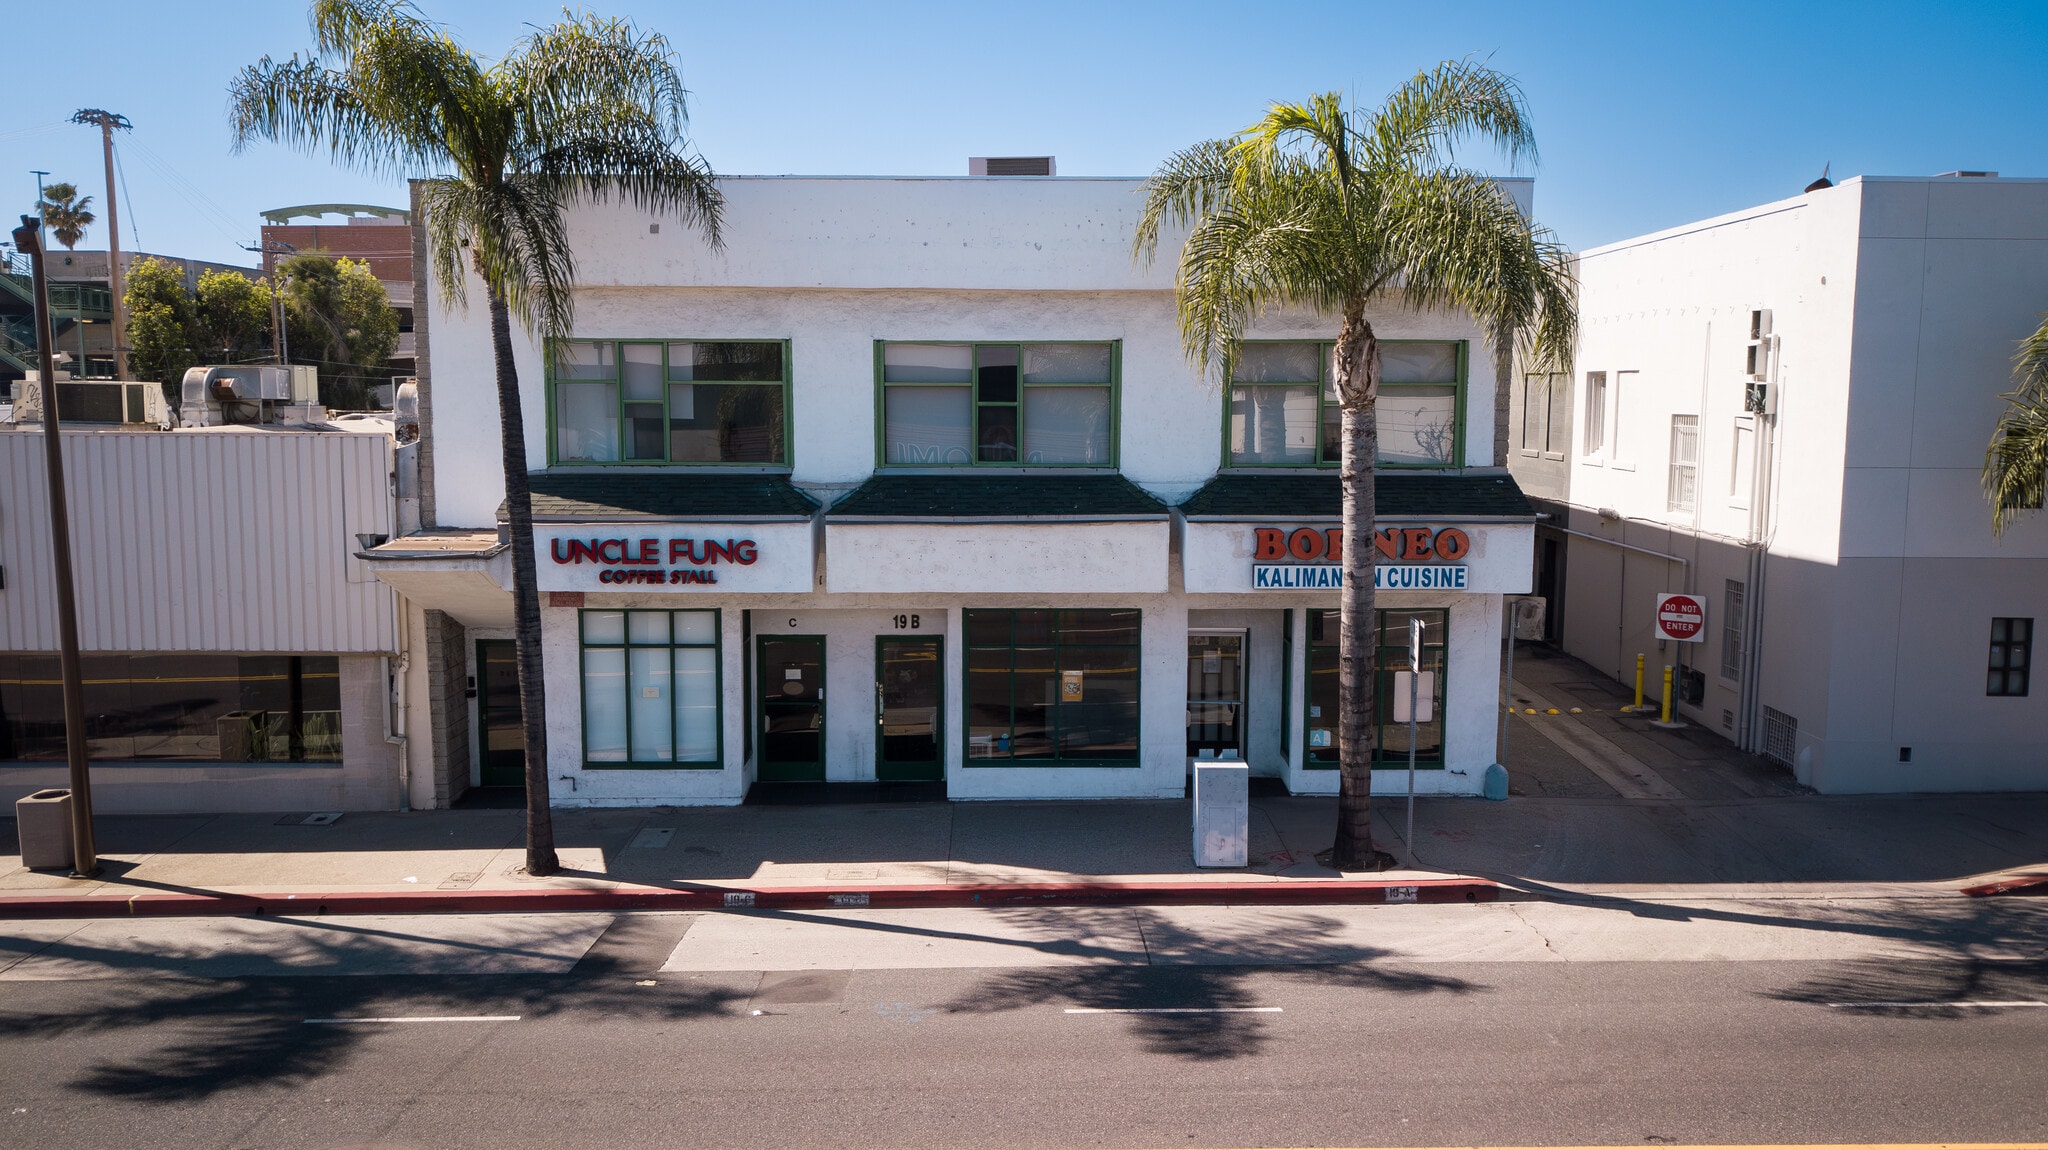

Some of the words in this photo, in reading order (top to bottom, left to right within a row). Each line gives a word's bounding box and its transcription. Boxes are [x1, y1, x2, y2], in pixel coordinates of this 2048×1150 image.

[551, 538, 659, 565] UNCLE
[668, 538, 758, 565] FUNG
[599, 569, 666, 585] COFFEE
[669, 569, 717, 585] STALL
[1257, 567, 1381, 587] KALIMAN
[1387, 567, 1466, 588] CUISINE
[1681, 605, 1697, 613] NOT
[788, 618, 797, 627] C
[893, 614, 907, 629] 19
[911, 614, 920, 629] B
[1666, 622, 1694, 631] ENTER
[1312, 733, 1322, 743] A
